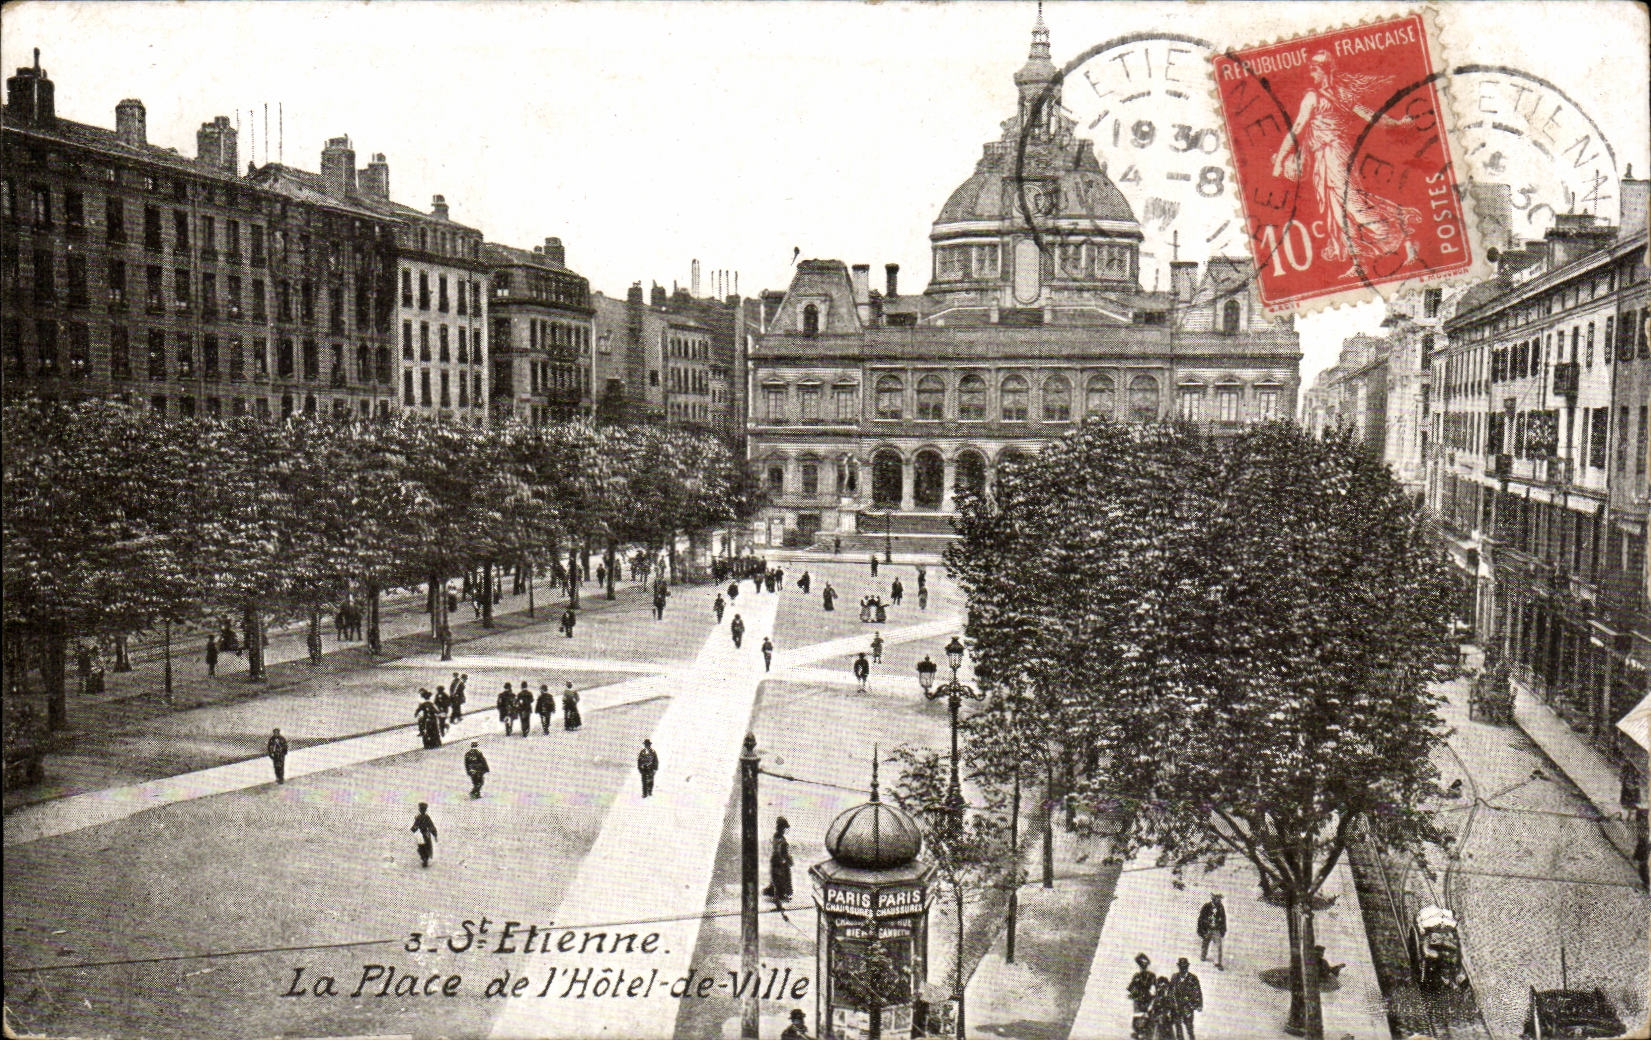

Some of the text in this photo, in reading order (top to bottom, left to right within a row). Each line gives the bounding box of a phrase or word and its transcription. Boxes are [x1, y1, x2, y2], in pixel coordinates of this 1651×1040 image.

[1334, 25, 1415, 57] FRANÇAISE
[1425, 172, 1459, 254] POSTES
[827, 888, 871, 909] PARIS
[878, 889, 921, 908] PARIS
